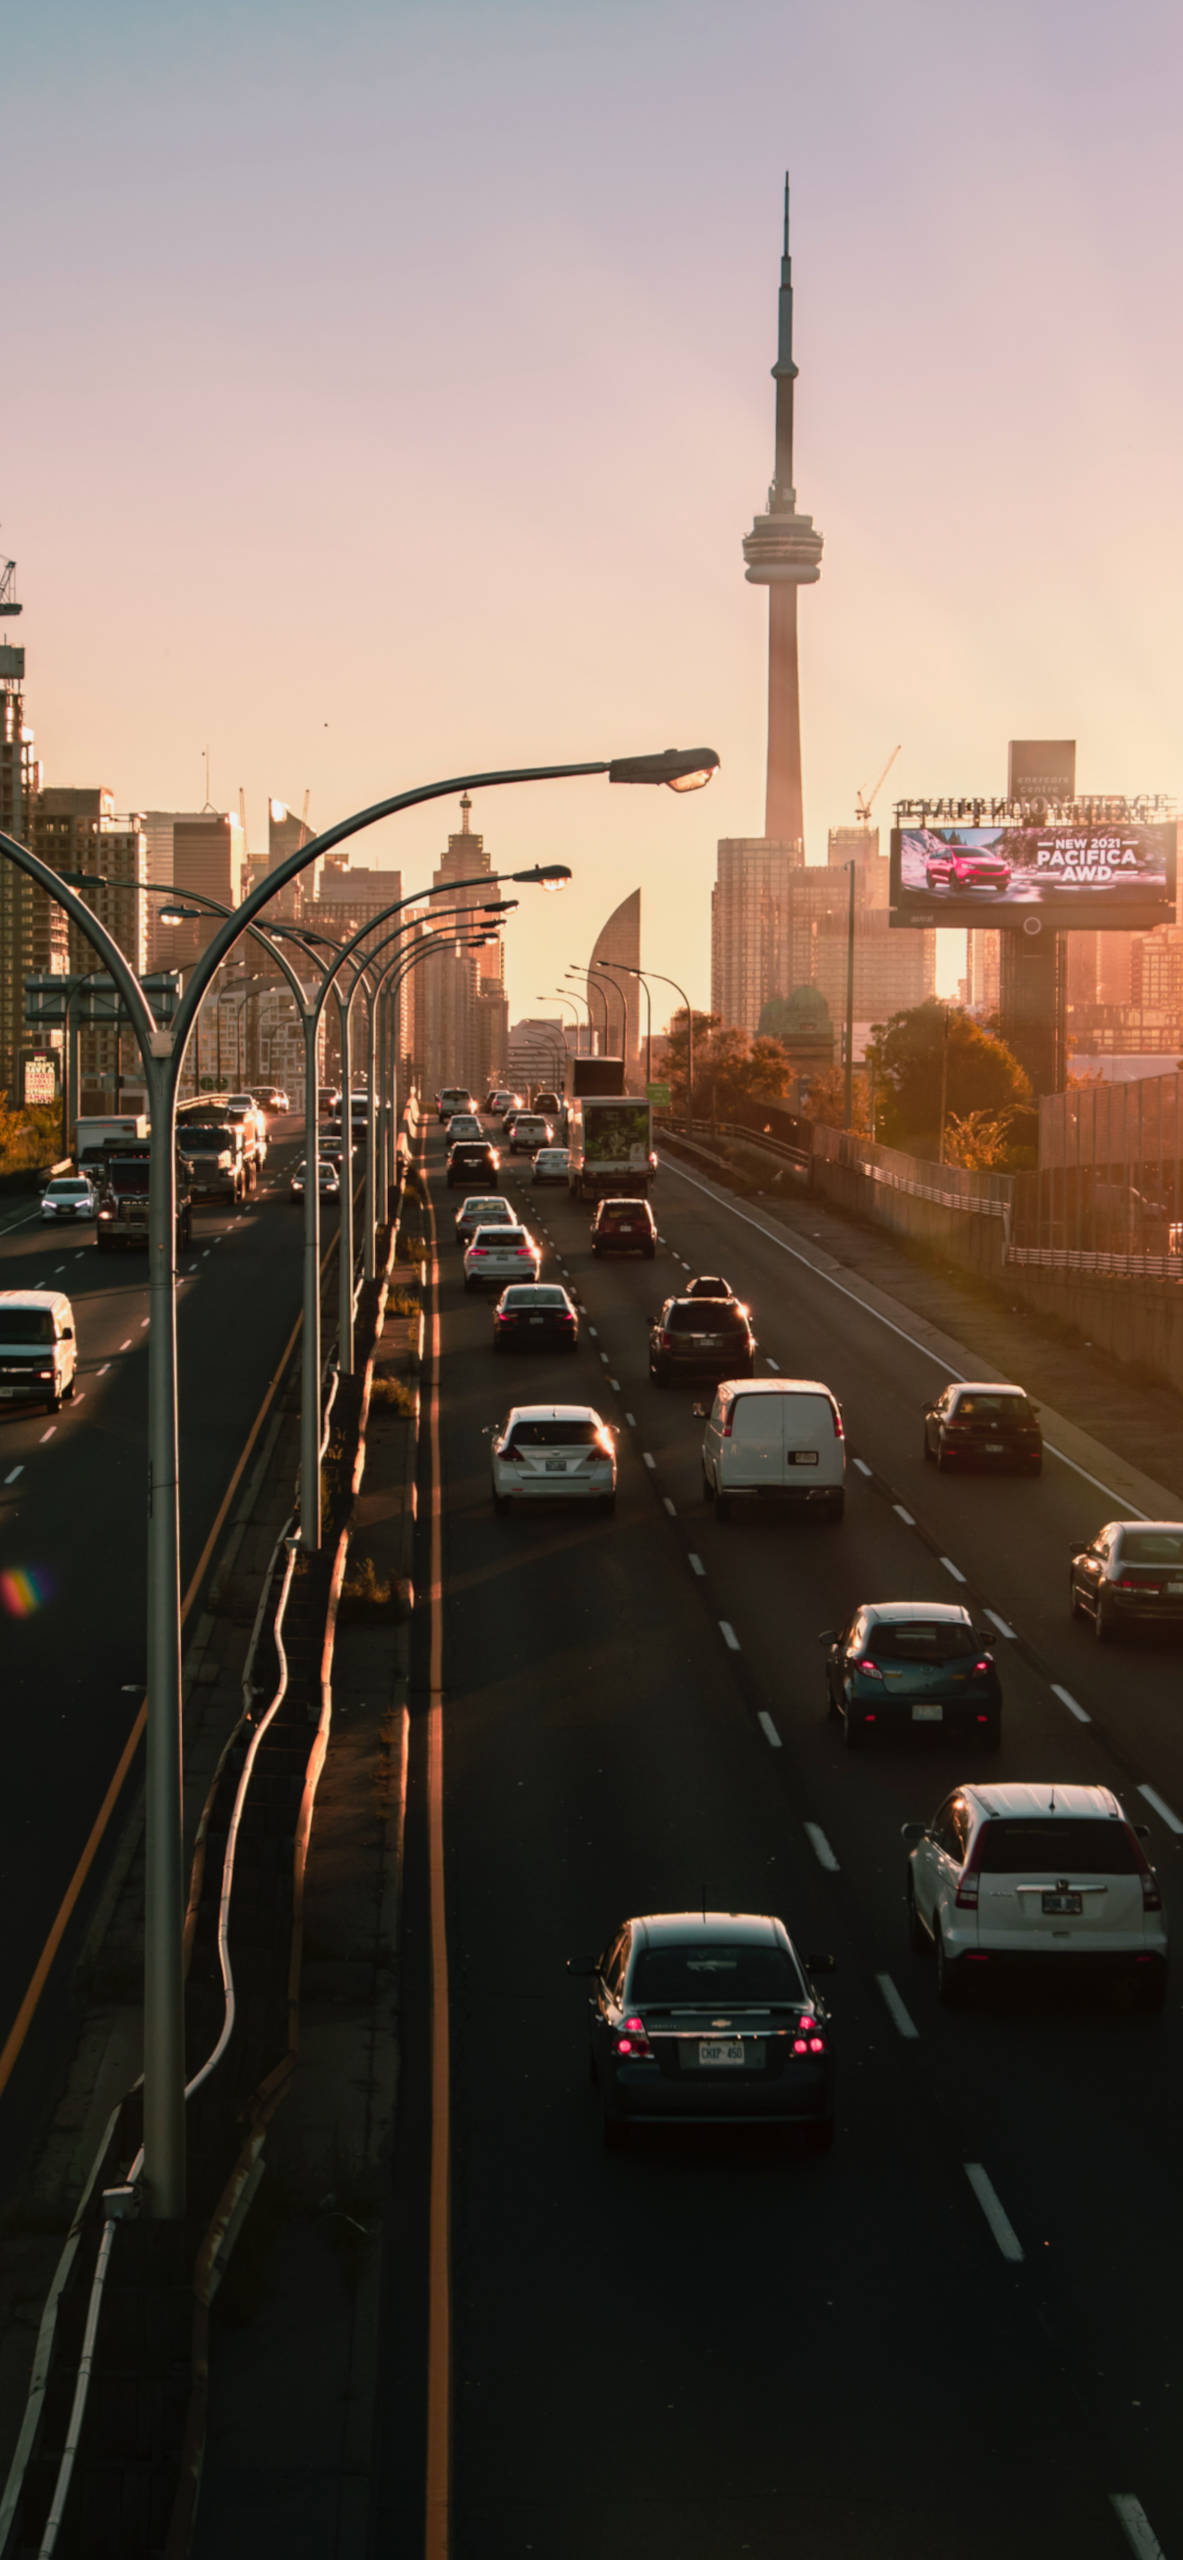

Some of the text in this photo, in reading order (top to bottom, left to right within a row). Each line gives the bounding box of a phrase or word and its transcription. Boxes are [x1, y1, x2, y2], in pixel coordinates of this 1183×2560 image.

[1020, 785, 1059, 793] centre
[1055, 838, 1121, 849] NEW 2021
[1037, 848, 1137, 866] PACIFICA
[1061, 866, 1113, 882] AWD
